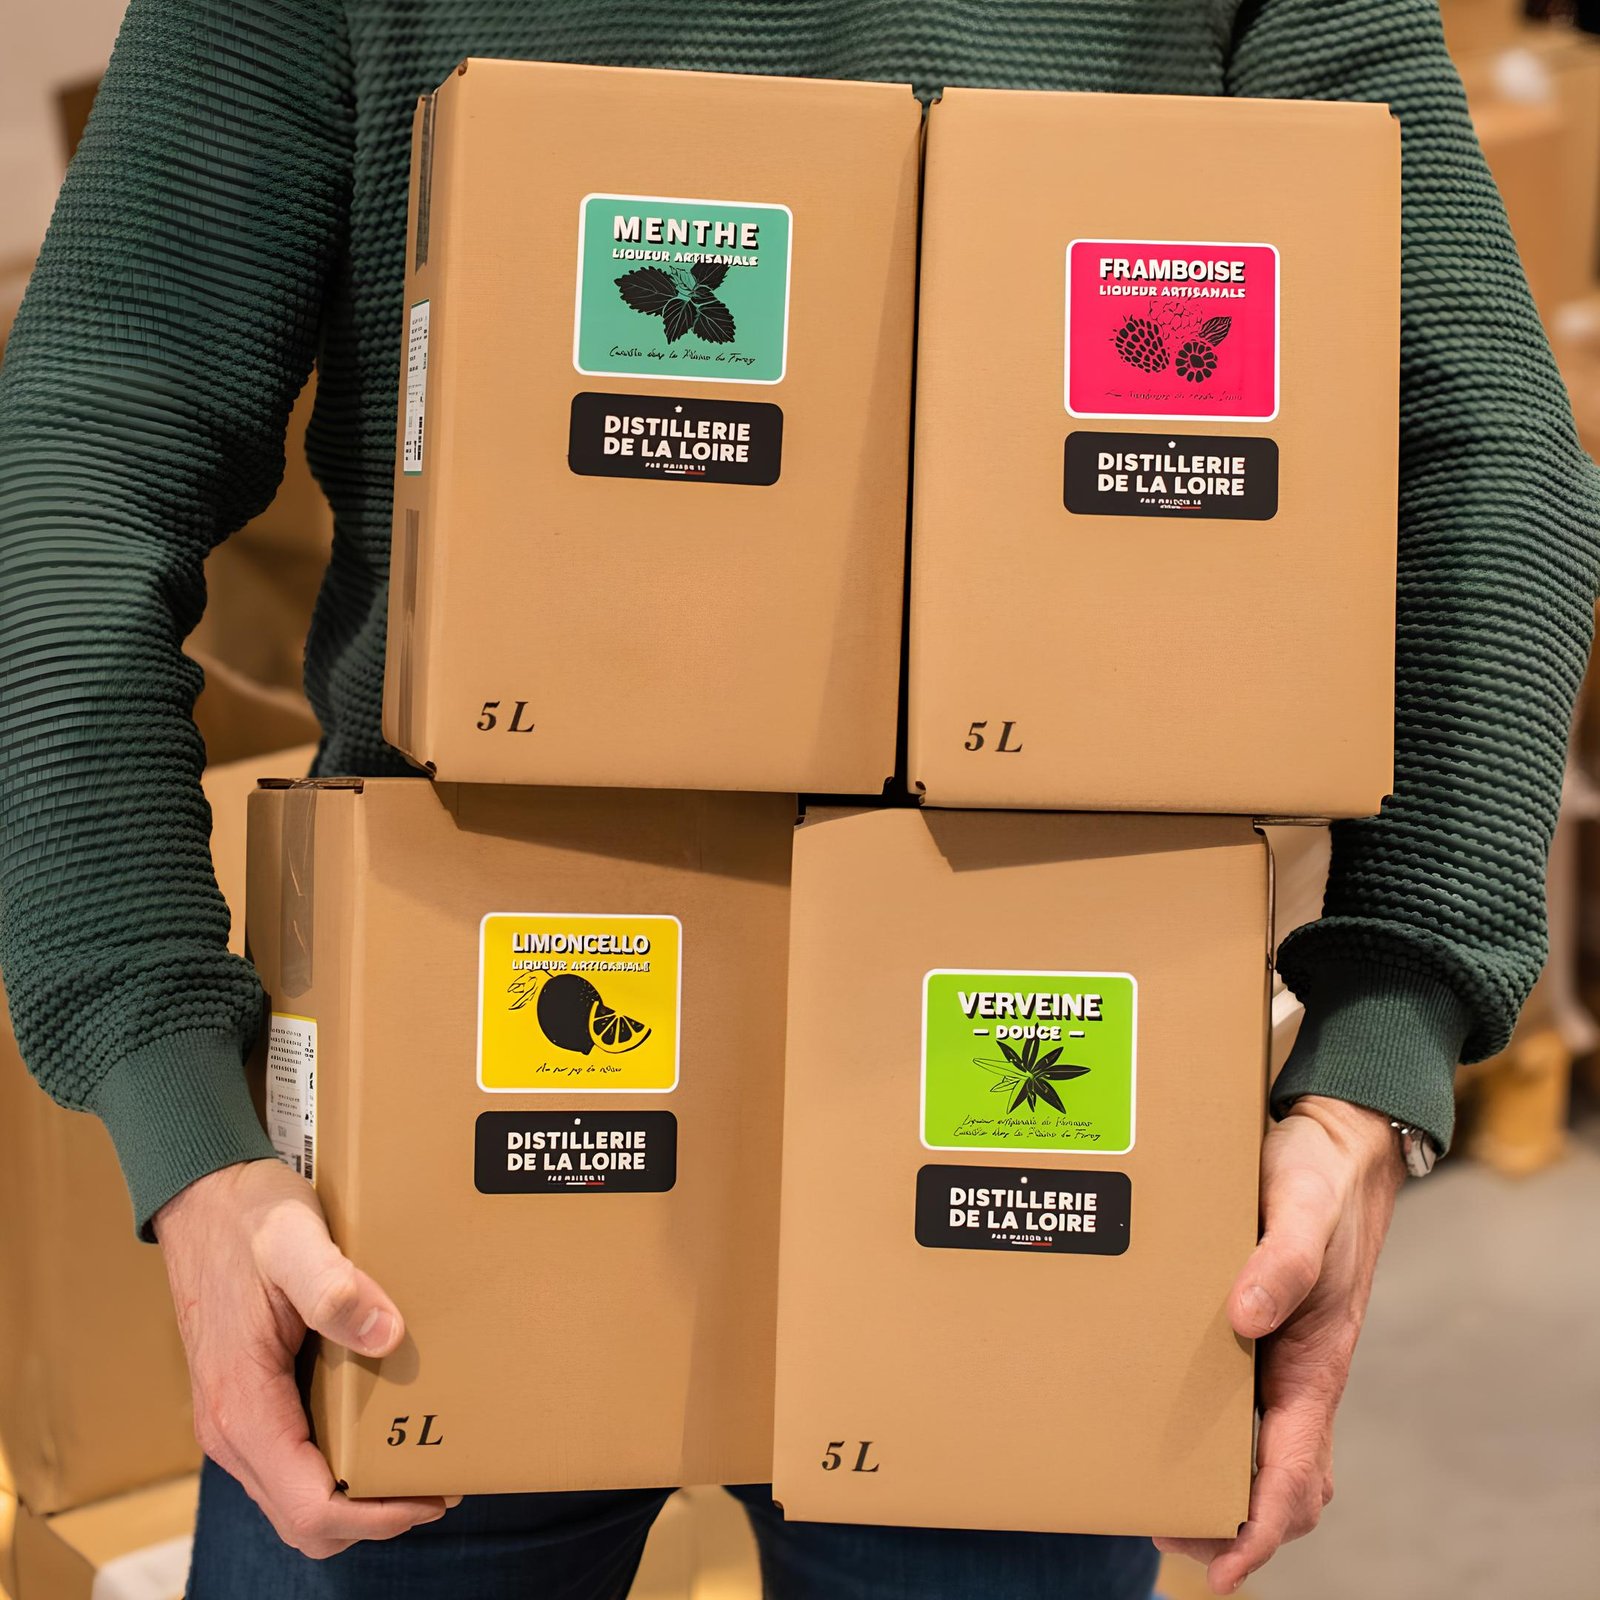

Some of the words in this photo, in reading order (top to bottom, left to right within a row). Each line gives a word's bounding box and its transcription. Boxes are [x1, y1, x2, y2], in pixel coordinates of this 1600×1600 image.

[613, 215, 760, 250] MENTHE
[612, 248, 670, 262] LIQUEUR
[674, 252, 759, 267] ARTISANALE
[1100, 258, 1246, 283] FRAMBOISE
[1100, 285, 1157, 296] LIQUEUR
[604, 415, 751, 442] DISTILLERIE
[603, 436, 635, 456] DE
[641, 439, 672, 458] LA
[679, 441, 749, 463] LOIRE
[1098, 452, 1246, 475] DISTILLERIE
[1097, 474, 1128, 492] DE
[1136, 475, 1167, 493] LA
[1174, 476, 1245, 496] LOIRE
[477, 700, 501, 732] 5
[507, 701, 535, 732] L
[964, 720, 988, 752] 5
[995, 721, 1023, 752] L
[512, 932, 651, 955] LIMONCELLO
[957, 991, 1103, 1021] VERVEINE
[995, 1025, 1062, 1041] DOUCE
[507, 1131, 646, 1150] DISTILLERIE
[507, 1152, 536, 1171] DE
[543, 1152, 573, 1171] LA
[580, 1152, 646, 1171] LOIRE
[950, 1187, 1097, 1212] DISTILLERIE
[949, 1208, 980, 1228] DE
[987, 1210, 1019, 1230] LA
[1026, 1212, 1097, 1233] LOIRE
[386, 1415, 410, 1447] 5
[415, 1414, 444, 1446] L
[821, 1440, 845, 1471] 5
[851, 1441, 880, 1472] L
